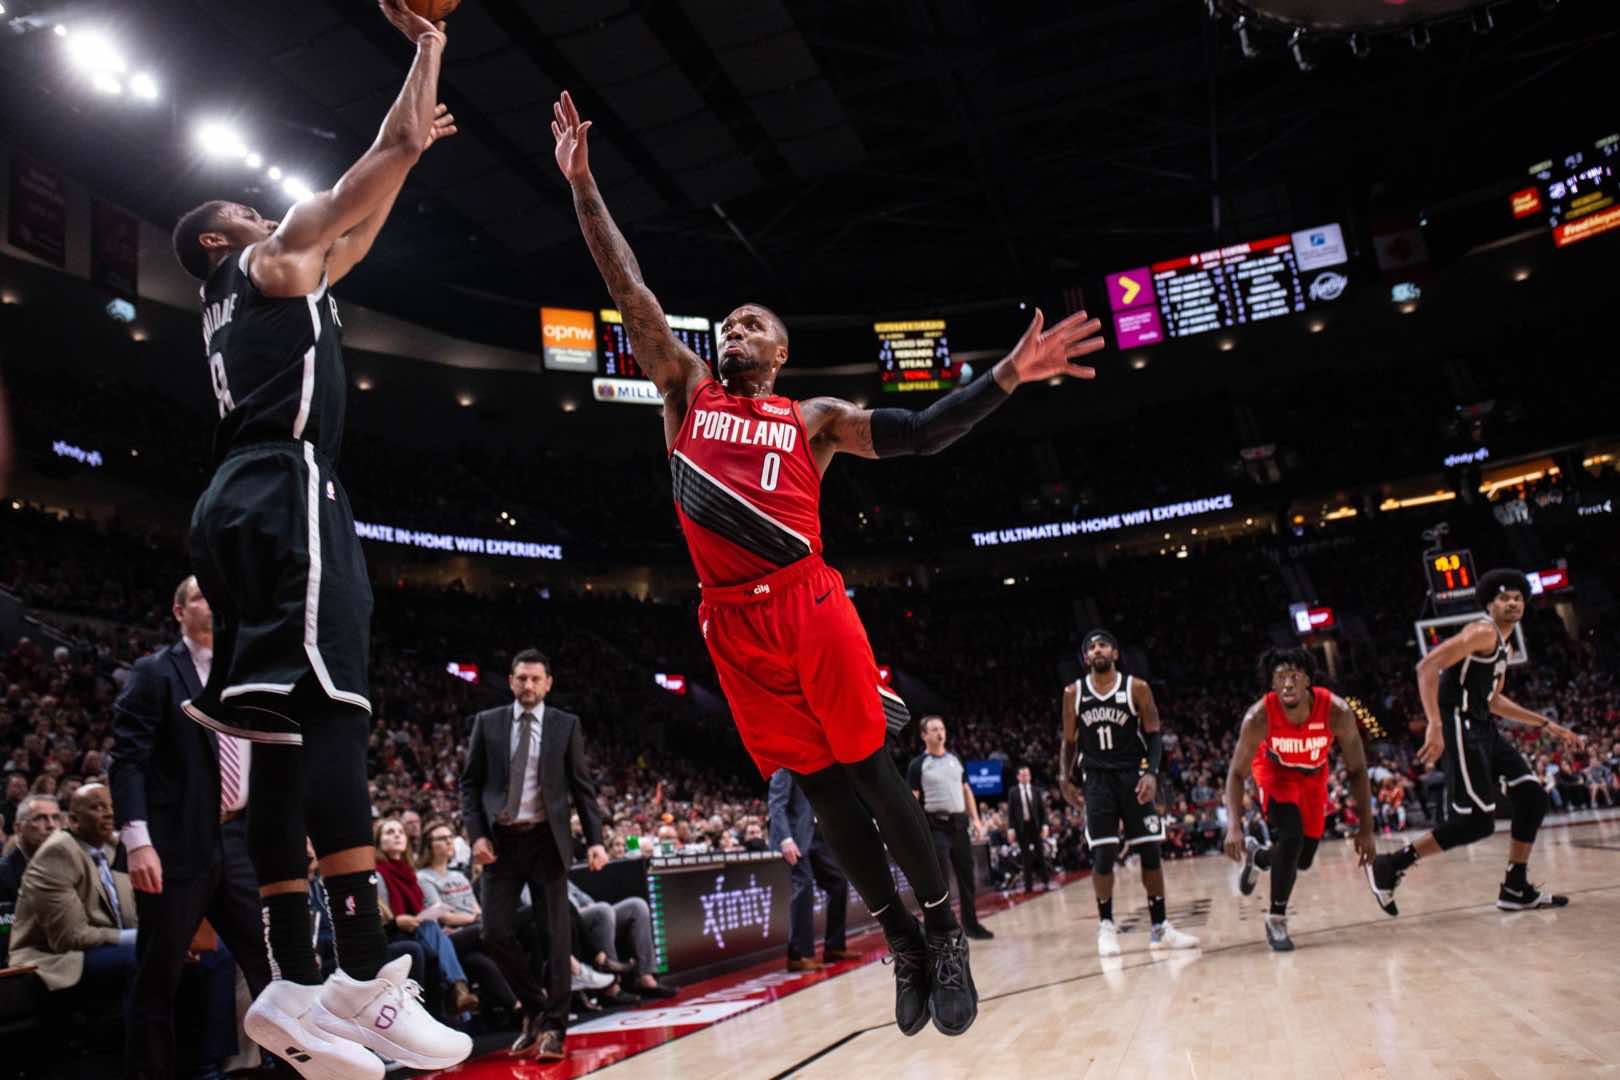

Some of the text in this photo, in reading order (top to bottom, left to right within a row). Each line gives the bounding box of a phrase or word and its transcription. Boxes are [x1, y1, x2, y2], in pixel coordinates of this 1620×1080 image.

[691, 409, 797, 453] PORTLAND
[760, 452, 781, 491] 0
[972, 494, 1233, 547] THE ULTIMATE IN-HOME WIFI EXPERIENCE
[395, 528, 454, 550] IN-HOME
[454, 536, 485, 553] WIFI
[485, 539, 562, 560] EXPERIENCE
[1081, 706, 1130, 727] BROOKLYN
[1096, 725, 1113, 751] 11
[1271, 736, 1328, 753] PORTLAND
